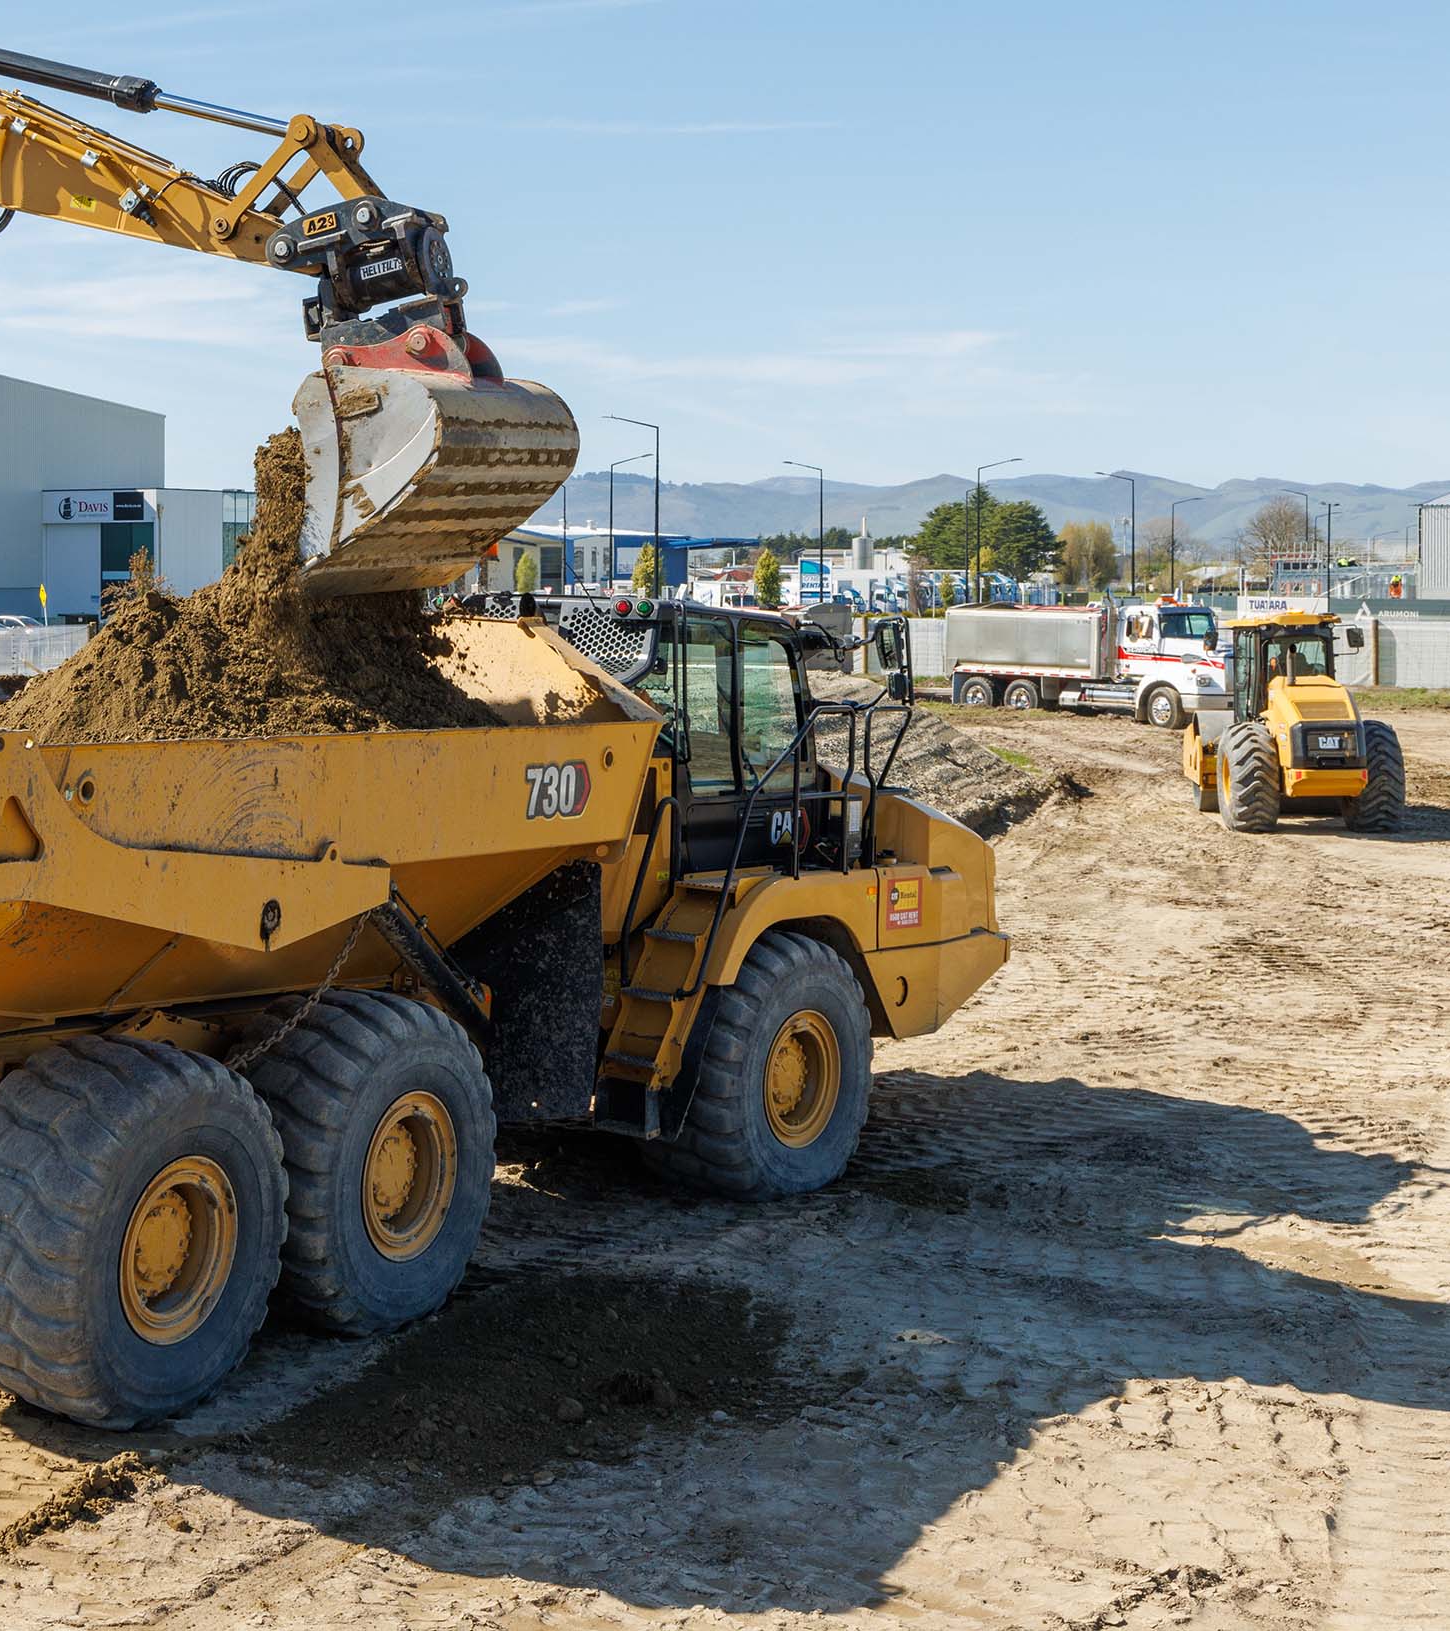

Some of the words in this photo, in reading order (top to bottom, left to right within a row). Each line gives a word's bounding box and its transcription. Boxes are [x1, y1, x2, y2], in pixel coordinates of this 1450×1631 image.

[78, 501, 109, 512] DAVIS
[1318, 737, 1340, 749] CAT
[527, 765, 576, 817] 730
[770, 810, 802, 845] CA
